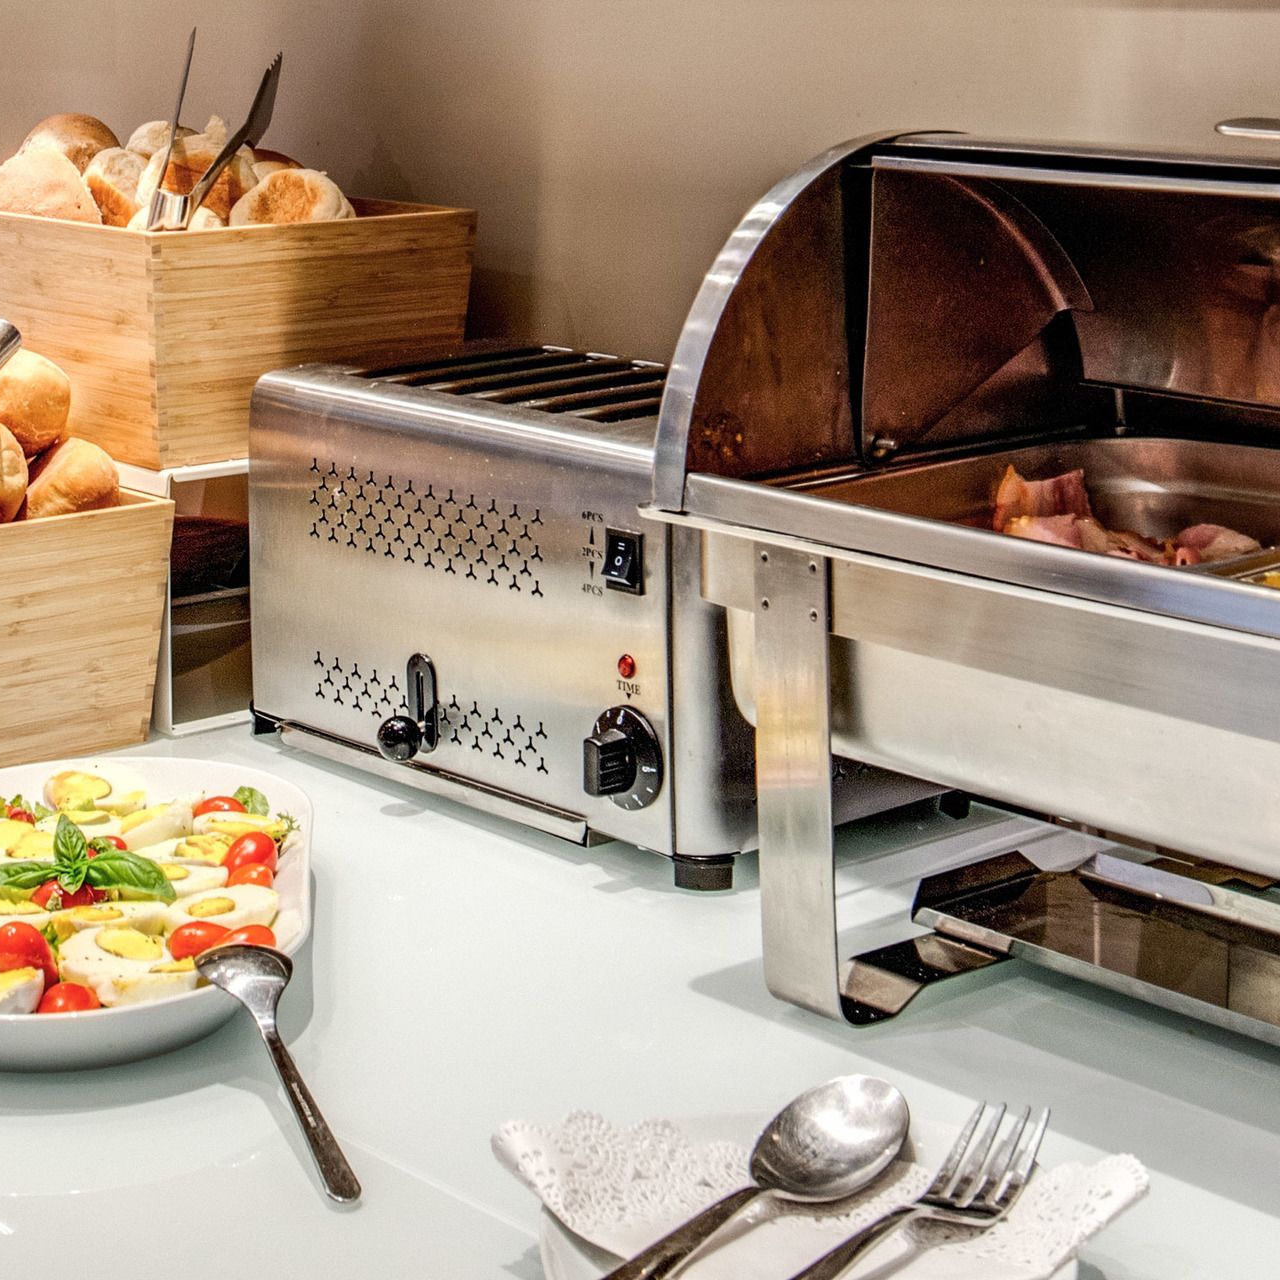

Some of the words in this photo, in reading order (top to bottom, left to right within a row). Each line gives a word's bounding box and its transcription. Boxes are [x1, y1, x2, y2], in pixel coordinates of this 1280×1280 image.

[581, 510, 604, 523] 6PCS
[581, 546, 603, 559] 2PCS
[581, 583, 603, 597] 4PCS
[616, 679, 641, 695] TIME
